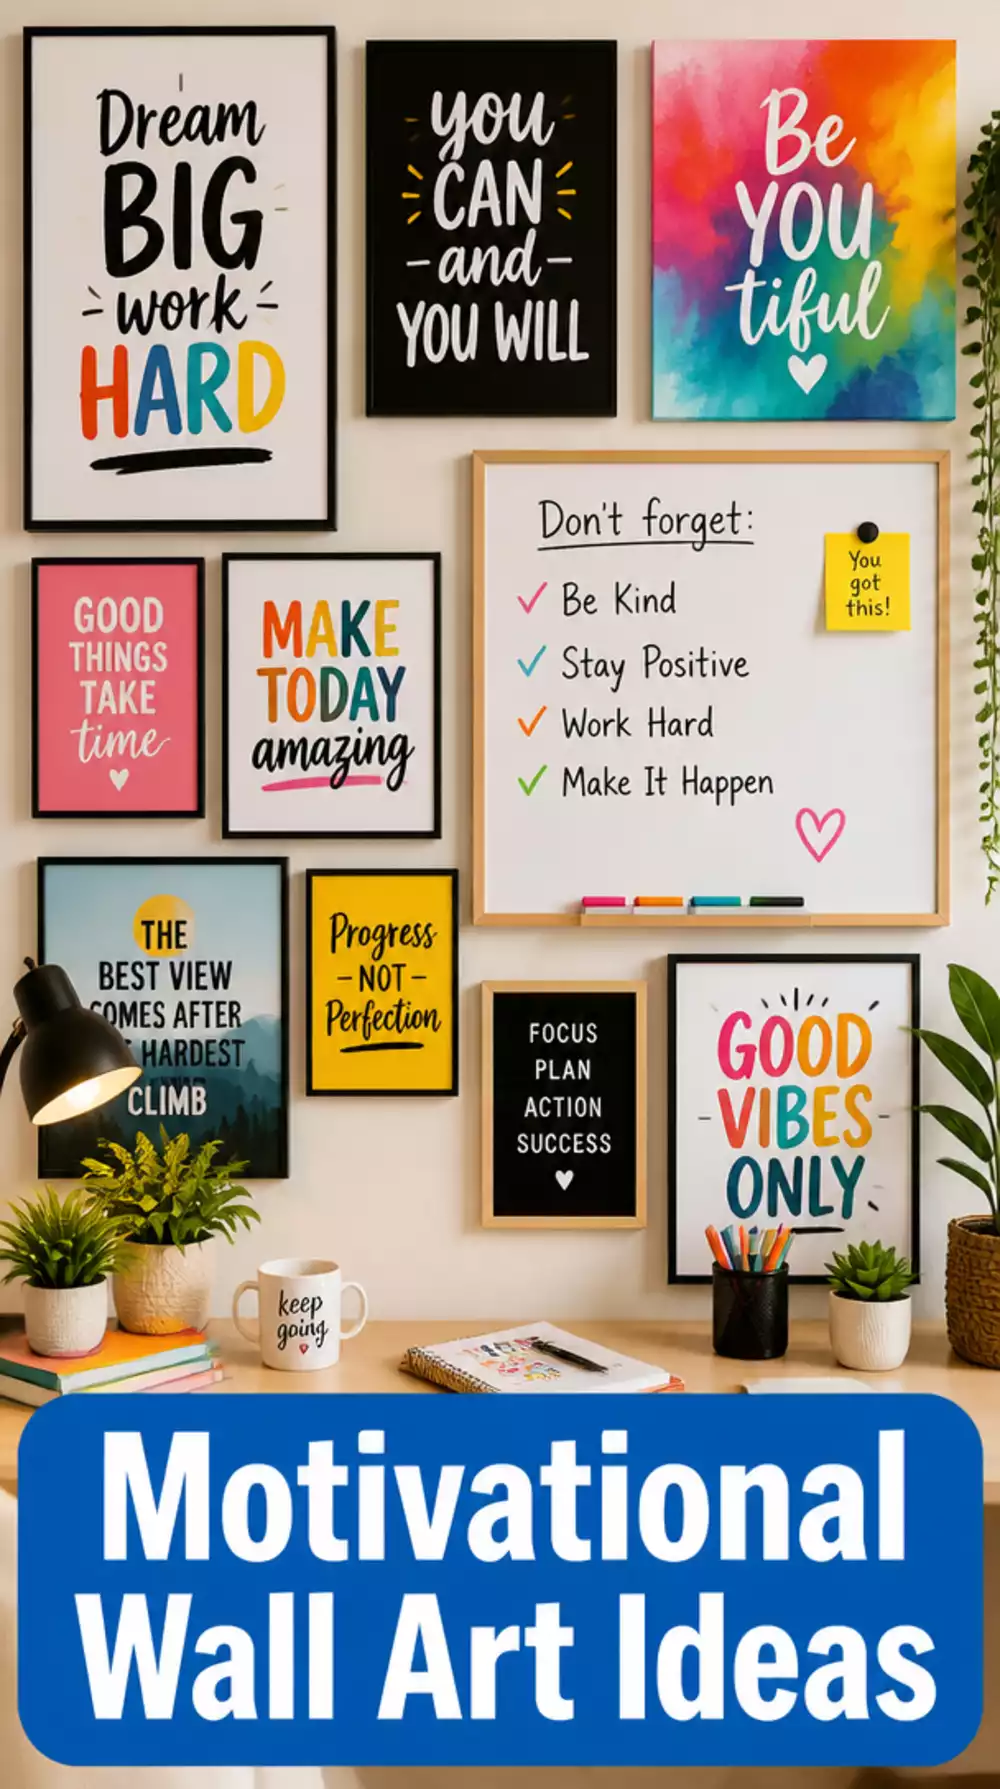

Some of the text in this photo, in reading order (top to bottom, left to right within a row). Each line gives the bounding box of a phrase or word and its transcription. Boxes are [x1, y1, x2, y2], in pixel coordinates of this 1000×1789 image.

[96, 88, 266, 157] Dream
[430, 91, 555, 162] you
[760, 87, 857, 176] Be
[433, 158, 543, 231] CAN
[104, 156, 263, 278] BIG
[735, 180, 873, 268] YOU
[438, 228, 541, 286] and
[116, 274, 247, 335] work
[724, 260, 890, 352] tiful
[396, 299, 590, 368] YOU WILL
[80, 340, 286, 440] HARD
[538, 496, 754, 552] Don't forget:
[848, 550, 882, 569] You
[562, 581, 676, 616] Be Kind
[846, 597, 891, 617] this!
[850, 575, 881, 597] got
[73, 596, 164, 634] GOOD
[262, 599, 400, 659] MAKE
[69, 641, 167, 673] THINGS
[561, 643, 750, 692] Stay Positive
[80, 679, 156, 715] TAKE
[256, 665, 407, 723] TODAY
[70, 719, 171, 764] time
[562, 706, 714, 739] Work Hard
[251, 726, 416, 792] amazing
[562, 765, 774, 806] Make It Happen
[141, 919, 188, 951] THE
[329, 911, 438, 961] Progress
[99, 960, 233, 991] BEST VIEW
[358, 963, 406, 993] NOT
[173, 1000, 242, 1029] AFTER
[325, 998, 442, 1041] Perfection
[529, 1022, 599, 1044] FOCUS
[141, 1038, 246, 1068] HARDEST
[717, 1010, 873, 1081] GOOD
[535, 1059, 591, 1081] PLAN
[127, 1085, 208, 1117] CLIMB
[524, 1097, 602, 1118] ACTION
[717, 1084, 873, 1150] VIBES
[517, 1133, 612, 1154] SUCCESS
[726, 1155, 866, 1220] ONLY
[278, 1289, 323, 1320] keep
[277, 1319, 329, 1351] going
